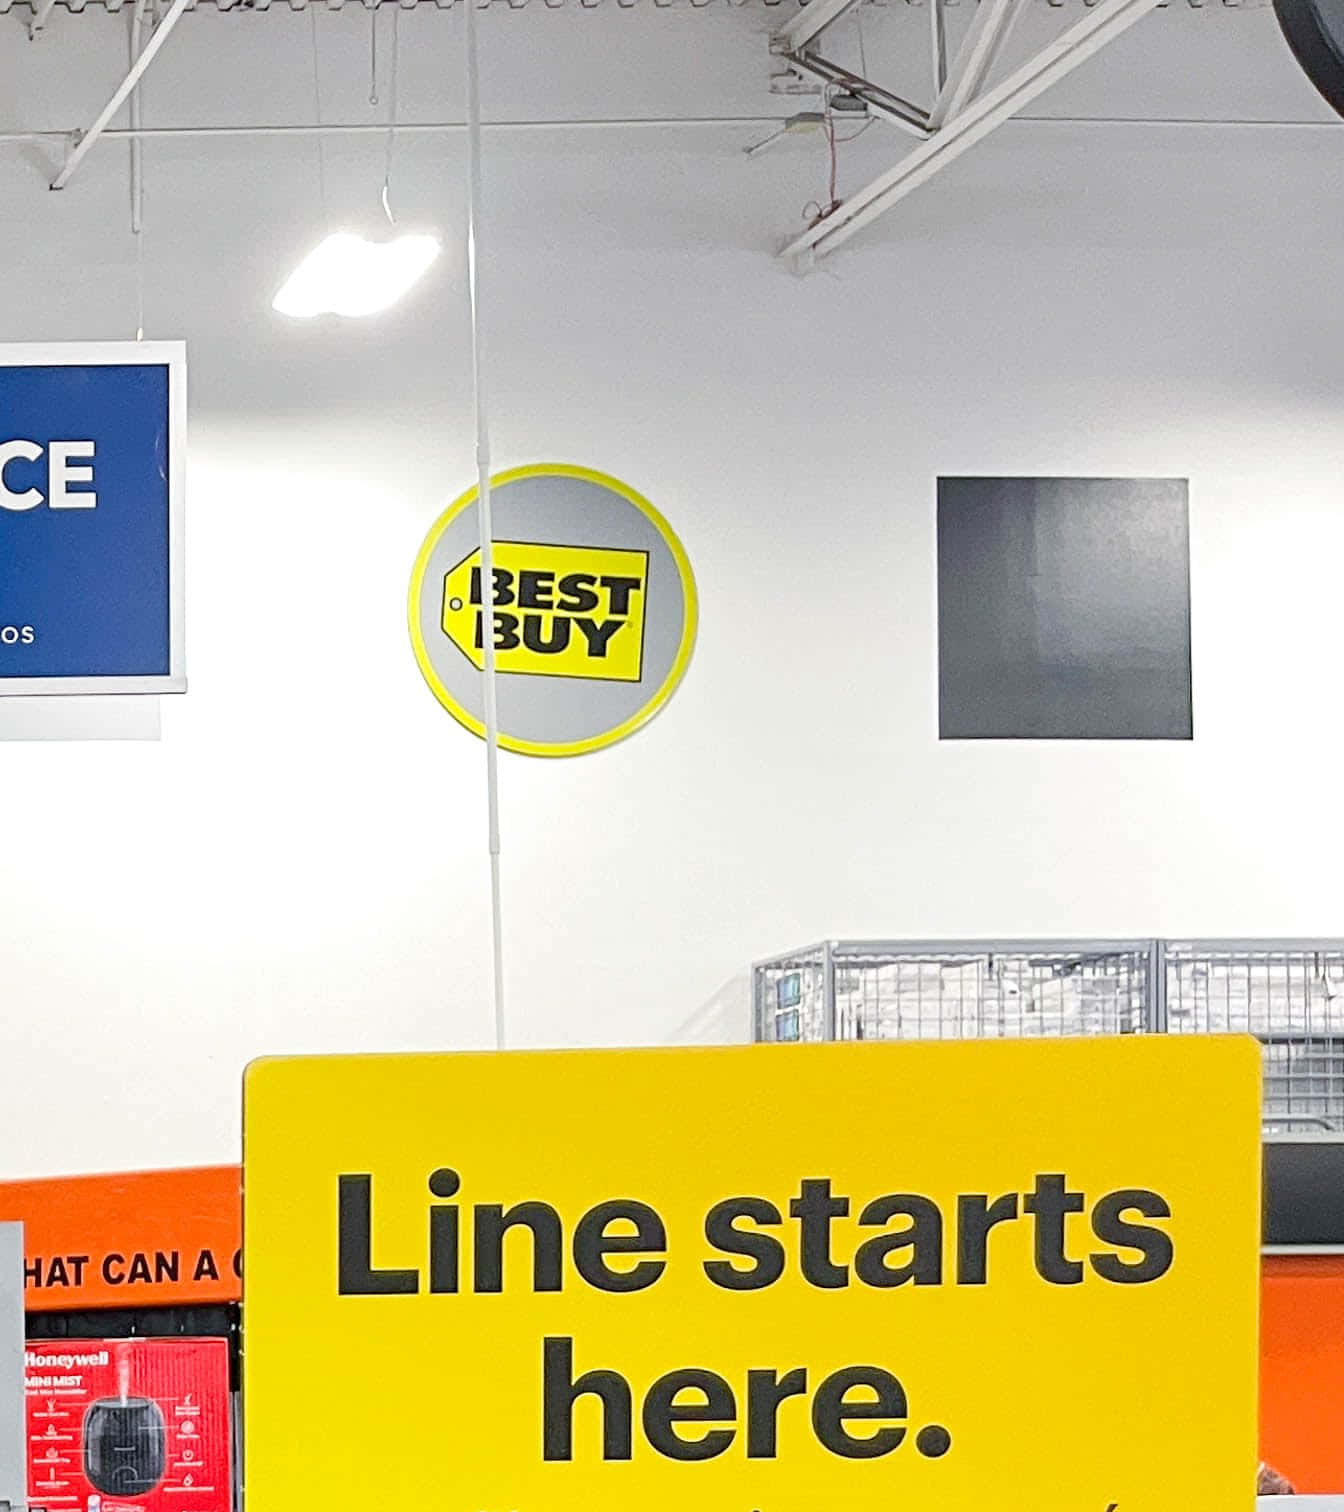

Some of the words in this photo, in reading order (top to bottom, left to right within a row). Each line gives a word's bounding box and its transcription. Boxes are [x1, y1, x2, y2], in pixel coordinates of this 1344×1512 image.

[470, 566, 641, 616] BEST
[474, 610, 627, 658] BUY
[337, 1168, 668, 1297] Line
[703, 1172, 1175, 1291] starts
[24, 1255, 89, 1289] HAT
[102, 1251, 179, 1286] CAN
[193, 1249, 219, 1282] A
[24, 1351, 109, 1369] Honeywell
[542, 1336, 951, 1463] here.
